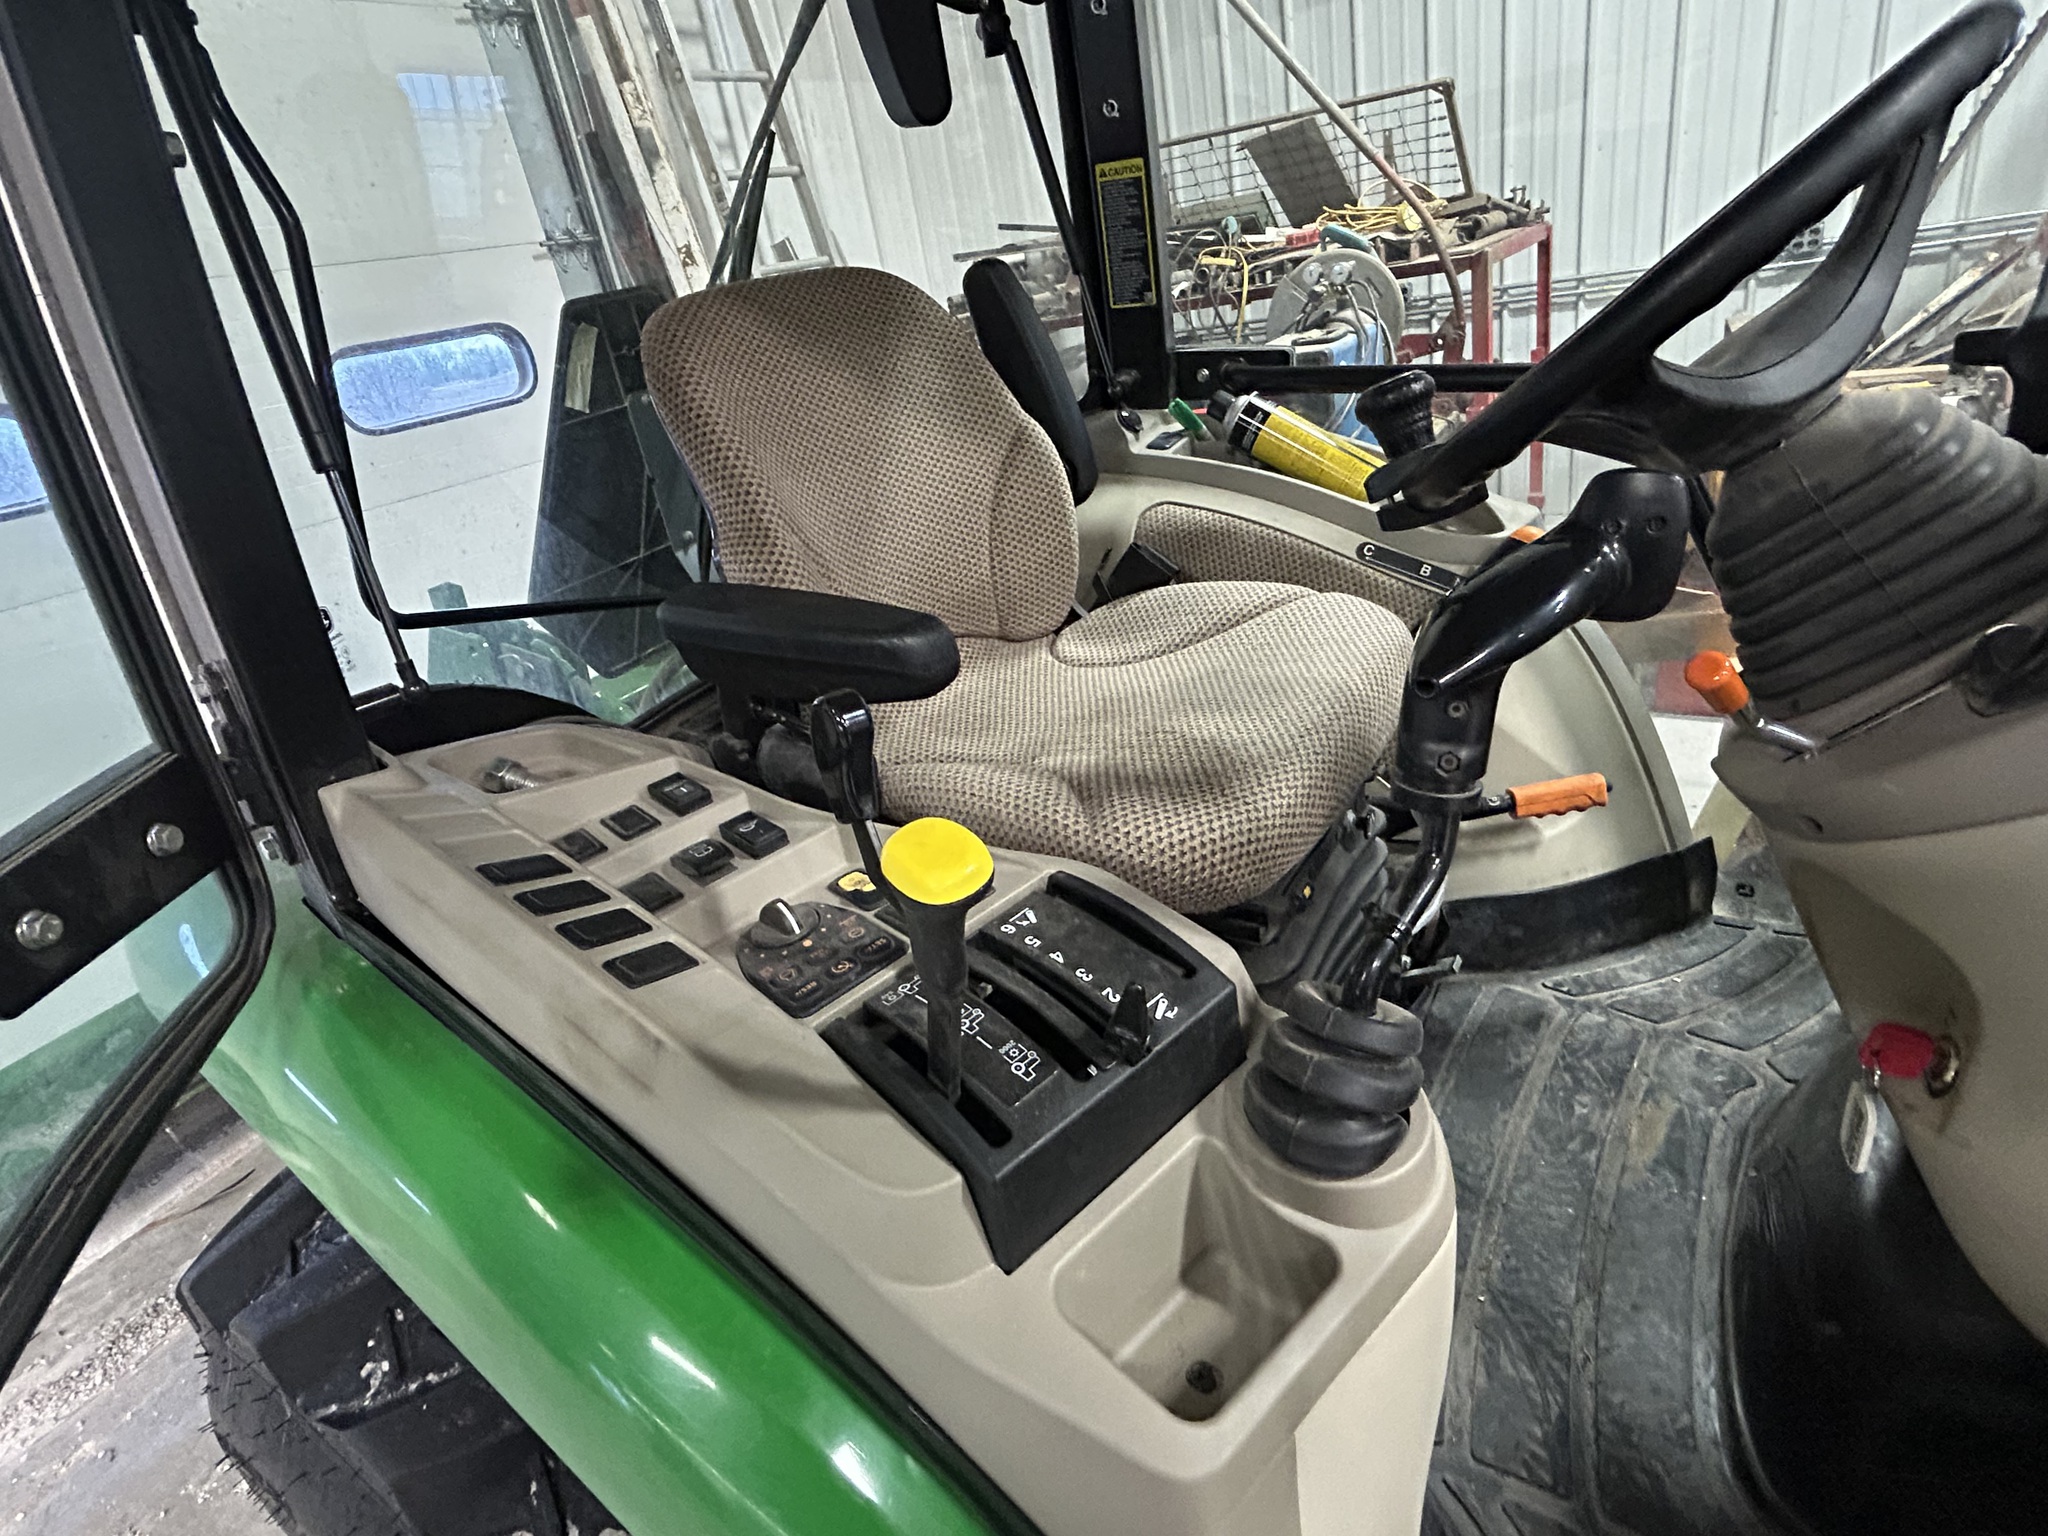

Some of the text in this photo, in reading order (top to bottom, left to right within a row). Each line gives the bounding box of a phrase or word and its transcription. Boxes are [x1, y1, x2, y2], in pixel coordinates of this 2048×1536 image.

[1107, 164, 1143, 177] CAUTION
[1363, 544, 1375, 556] C
[1419, 564, 1432, 576] B
[1000, 924, 1121, 1003] 2 3 4 5 6
